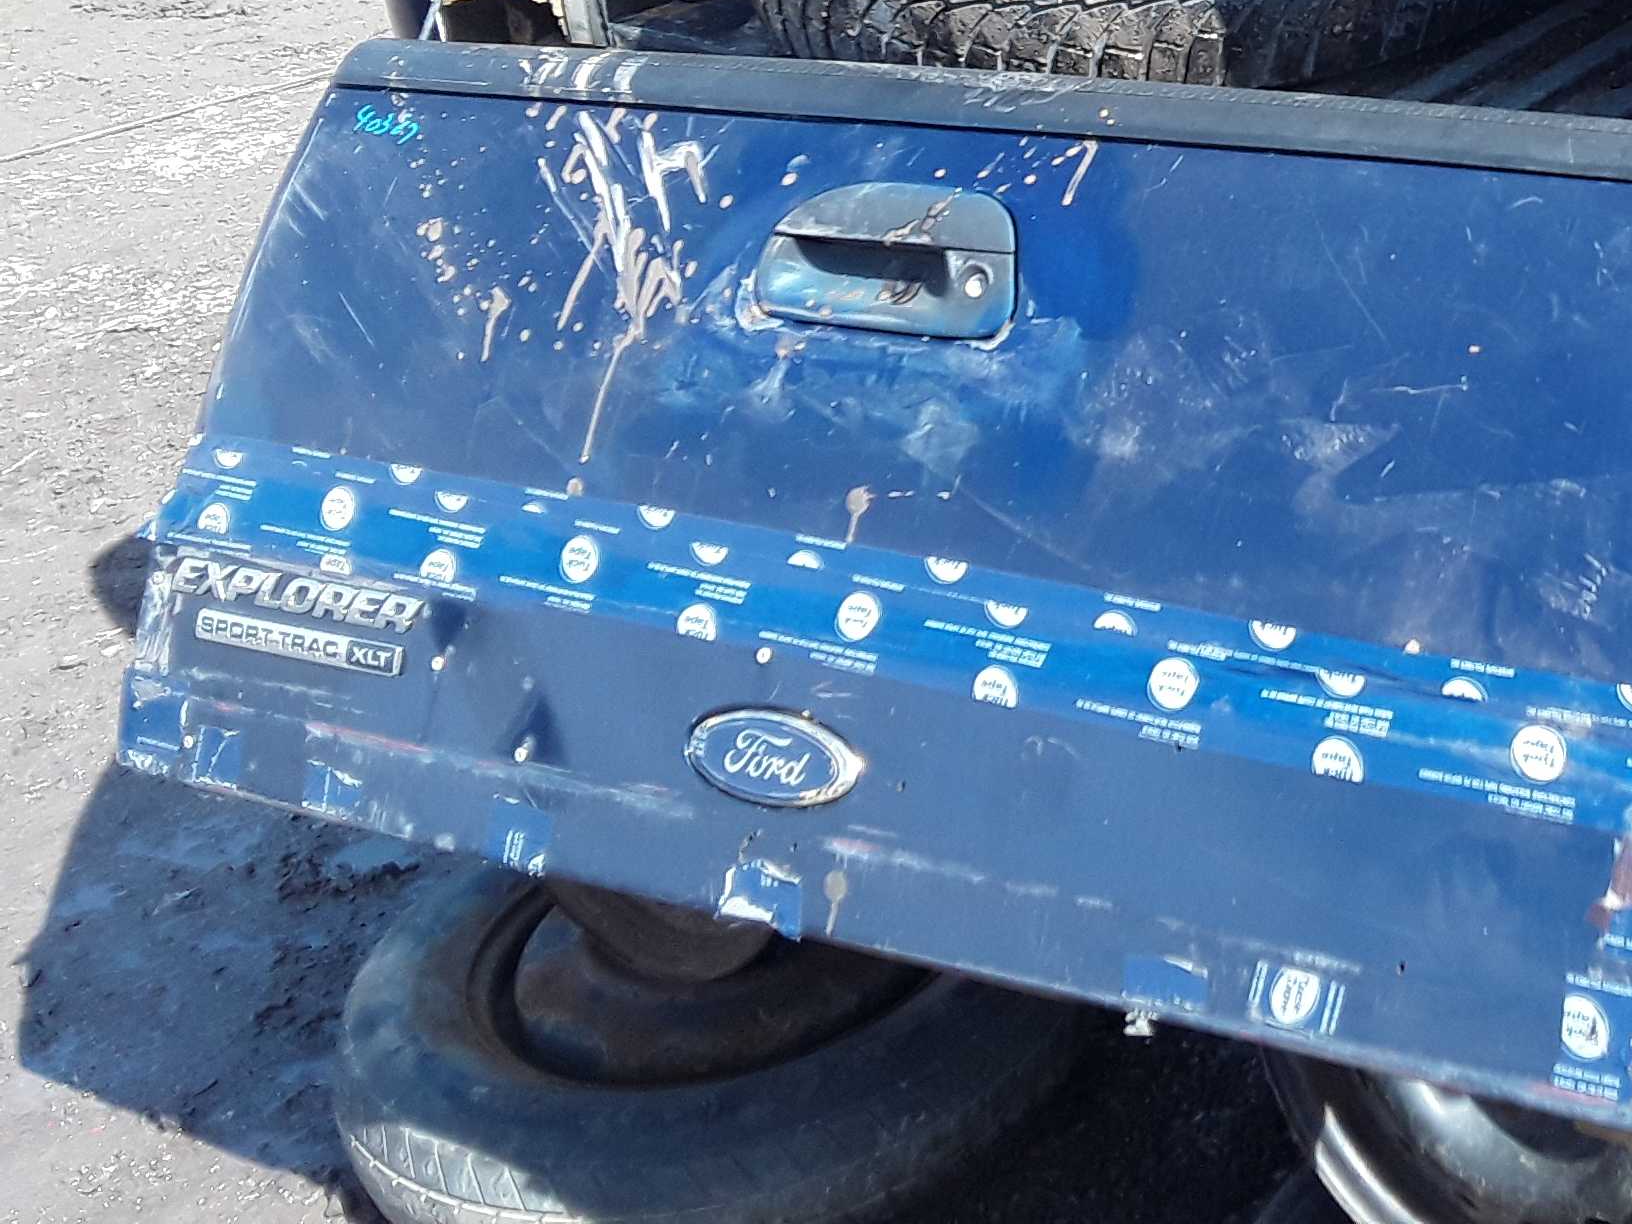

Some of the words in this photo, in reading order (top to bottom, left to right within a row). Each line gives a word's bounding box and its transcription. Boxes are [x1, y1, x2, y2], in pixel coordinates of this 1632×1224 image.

[172, 556, 426, 634] EXPLORER
[201, 616, 275, 647] SPORT
[279, 632, 340, 660] TRAC
[347, 645, 393, 671] XLT
[723, 728, 812, 786] Ford
